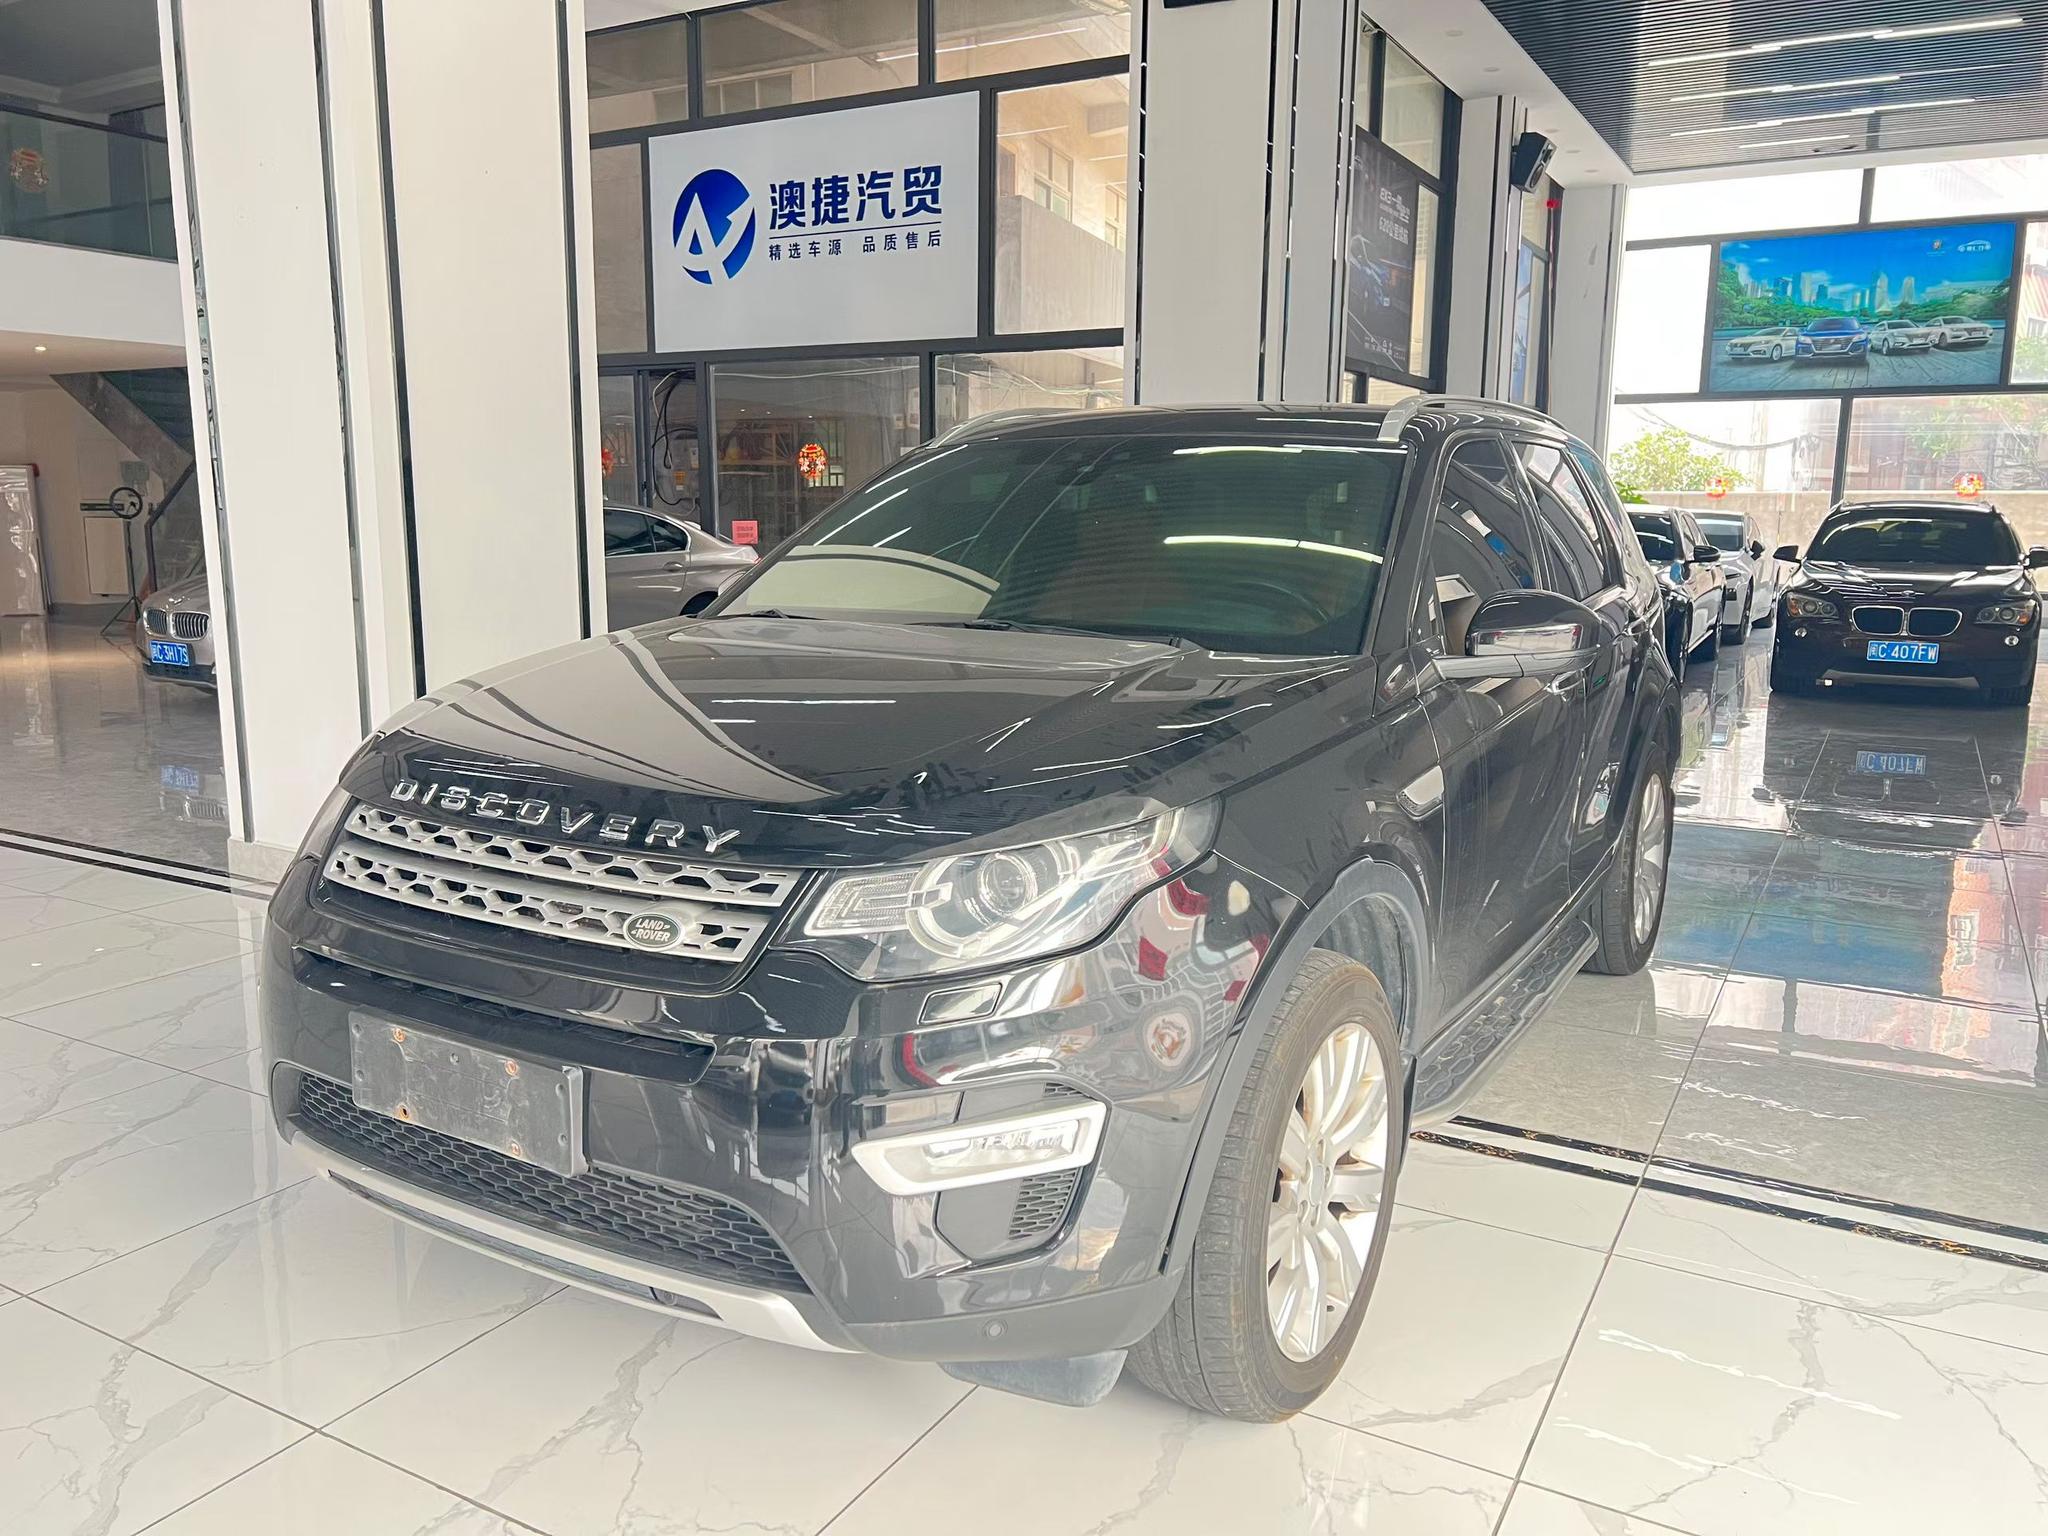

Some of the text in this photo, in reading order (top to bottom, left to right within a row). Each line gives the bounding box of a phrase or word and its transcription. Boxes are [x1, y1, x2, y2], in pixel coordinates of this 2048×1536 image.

[769, 165, 942, 230] 澳捷汽贸
[768, 230, 942, 261] 精选车源 品质售后
[390, 778, 742, 853] DISCOVERY
[635, 918, 664, 931] LAND
[635, 929, 670, 943] ROVER
